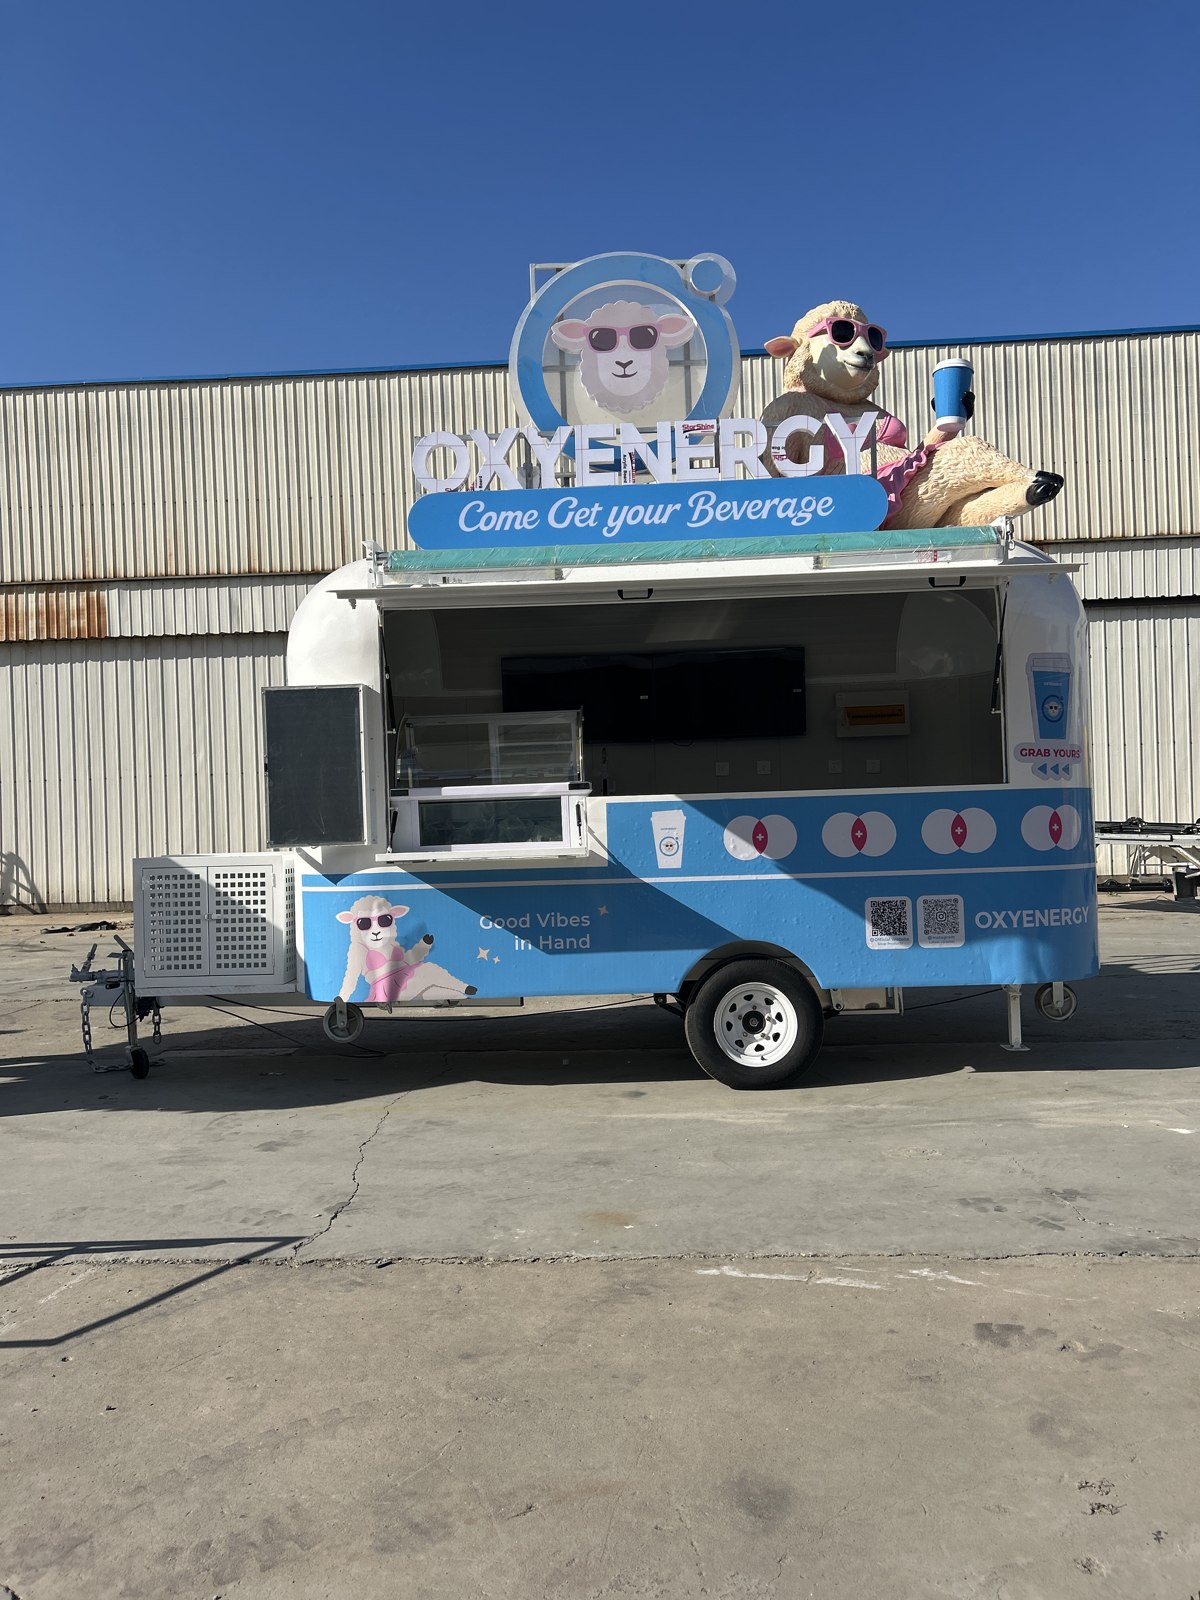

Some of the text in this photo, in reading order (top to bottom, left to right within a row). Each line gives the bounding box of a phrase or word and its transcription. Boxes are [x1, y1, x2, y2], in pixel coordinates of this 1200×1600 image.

[411, 411, 880, 493] OXYENERGY
[458, 490, 835, 538] Come Get your Beverage
[1019, 748, 1081, 759] GRAB YOURS
[479, 912, 591, 930] Good Vibes
[974, 906, 1089, 929] OXYENERGY
[514, 934, 591, 951] in Hand
